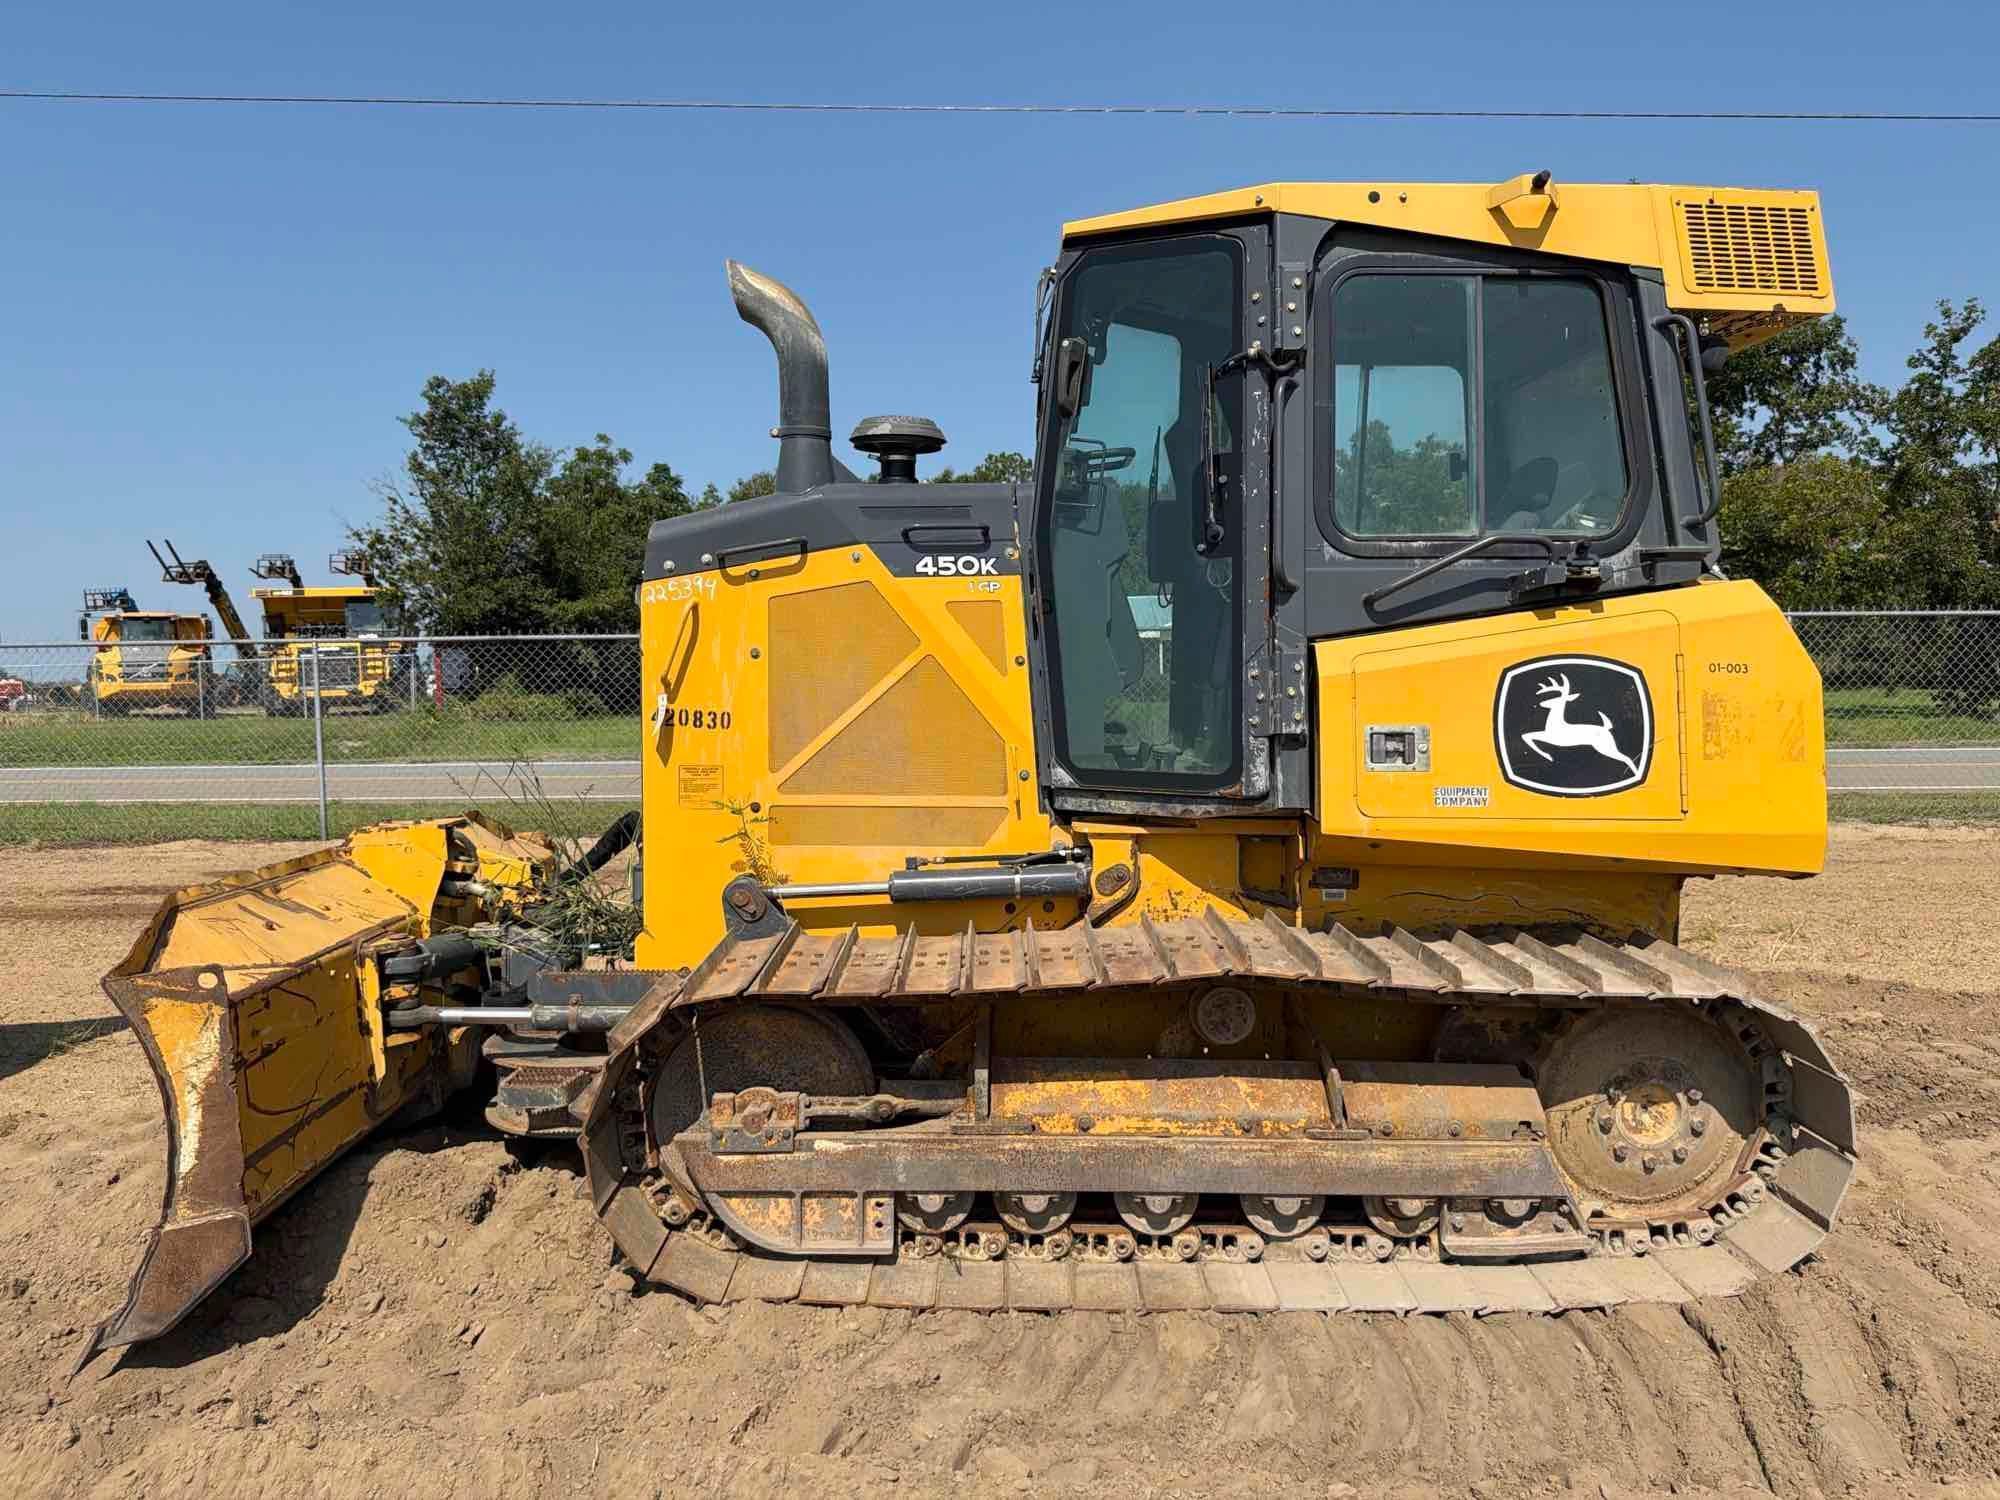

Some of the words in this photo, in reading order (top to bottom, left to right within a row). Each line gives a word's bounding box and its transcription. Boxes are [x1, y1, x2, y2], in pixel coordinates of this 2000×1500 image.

[915, 555, 999, 576] 450K
[1708, 663, 1749, 674] 01-003
[1433, 787, 1488, 796] EQUIPMENT
[1434, 796, 1488, 806] COMPANY
